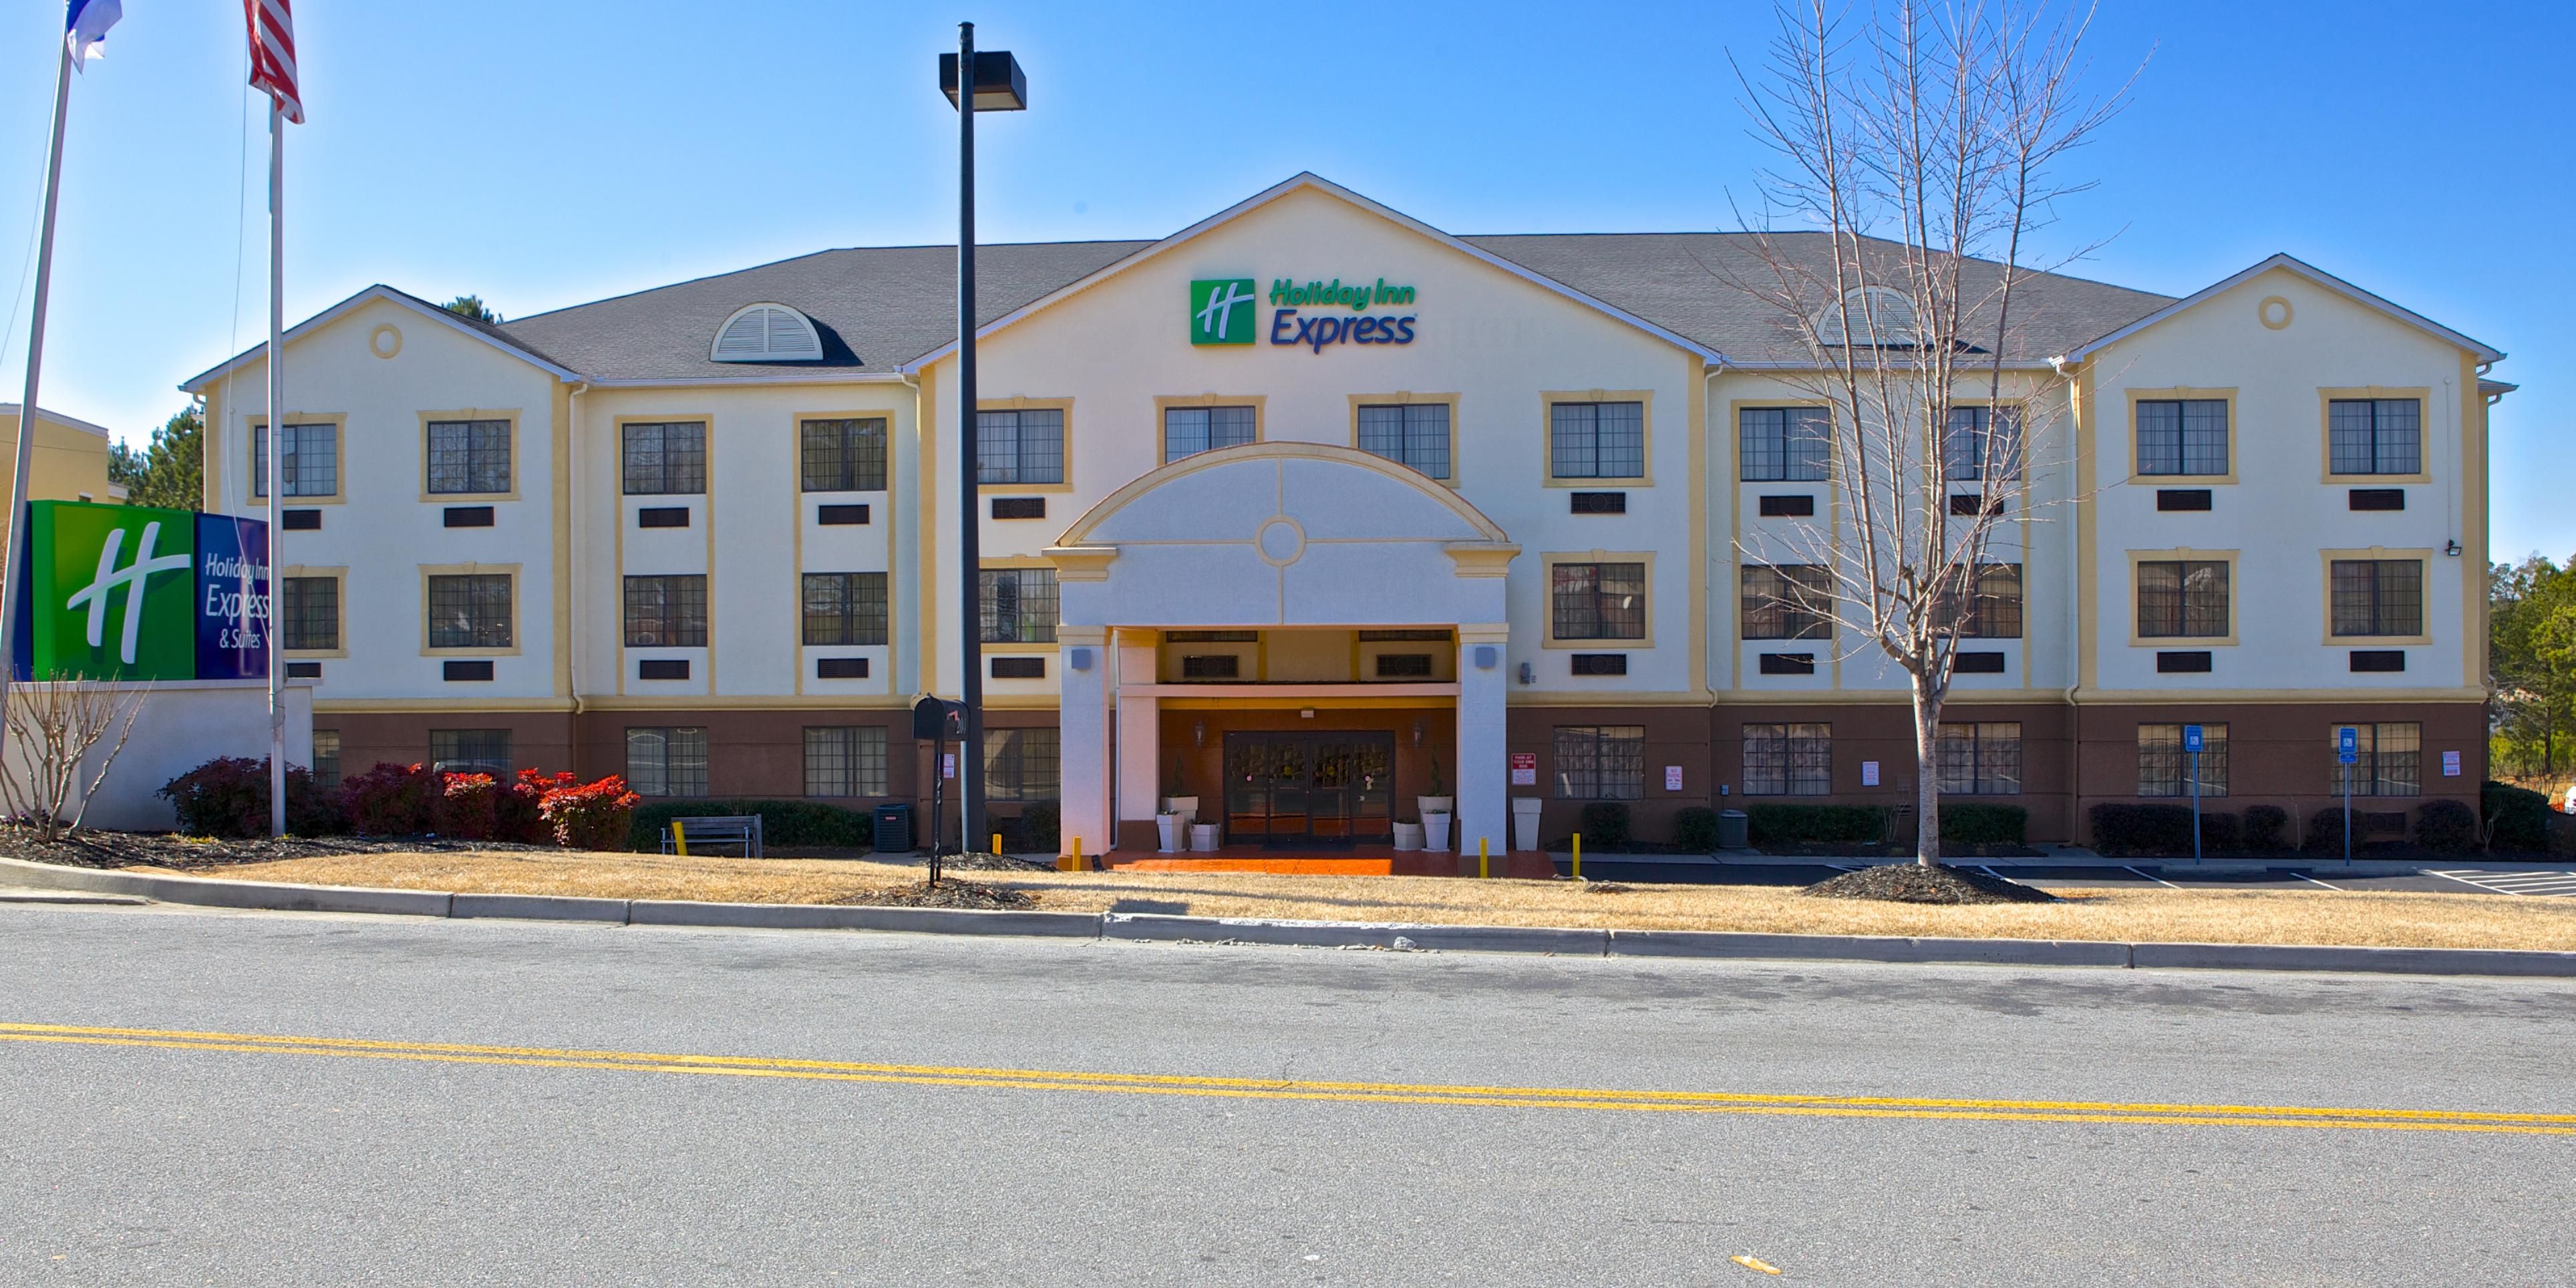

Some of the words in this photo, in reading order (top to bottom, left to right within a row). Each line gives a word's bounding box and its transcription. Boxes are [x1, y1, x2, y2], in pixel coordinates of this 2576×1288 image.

[1269, 278, 1371, 310] Holiday
[1374, 278, 1415, 304] Inn
[1271, 309, 1415, 355] Express
[205, 552, 255, 585] Holiday
[255, 557, 269, 581] Inn
[206, 583, 269, 626] Express
[219, 628, 229, 648] &
[230, 629, 261, 649] Suites
